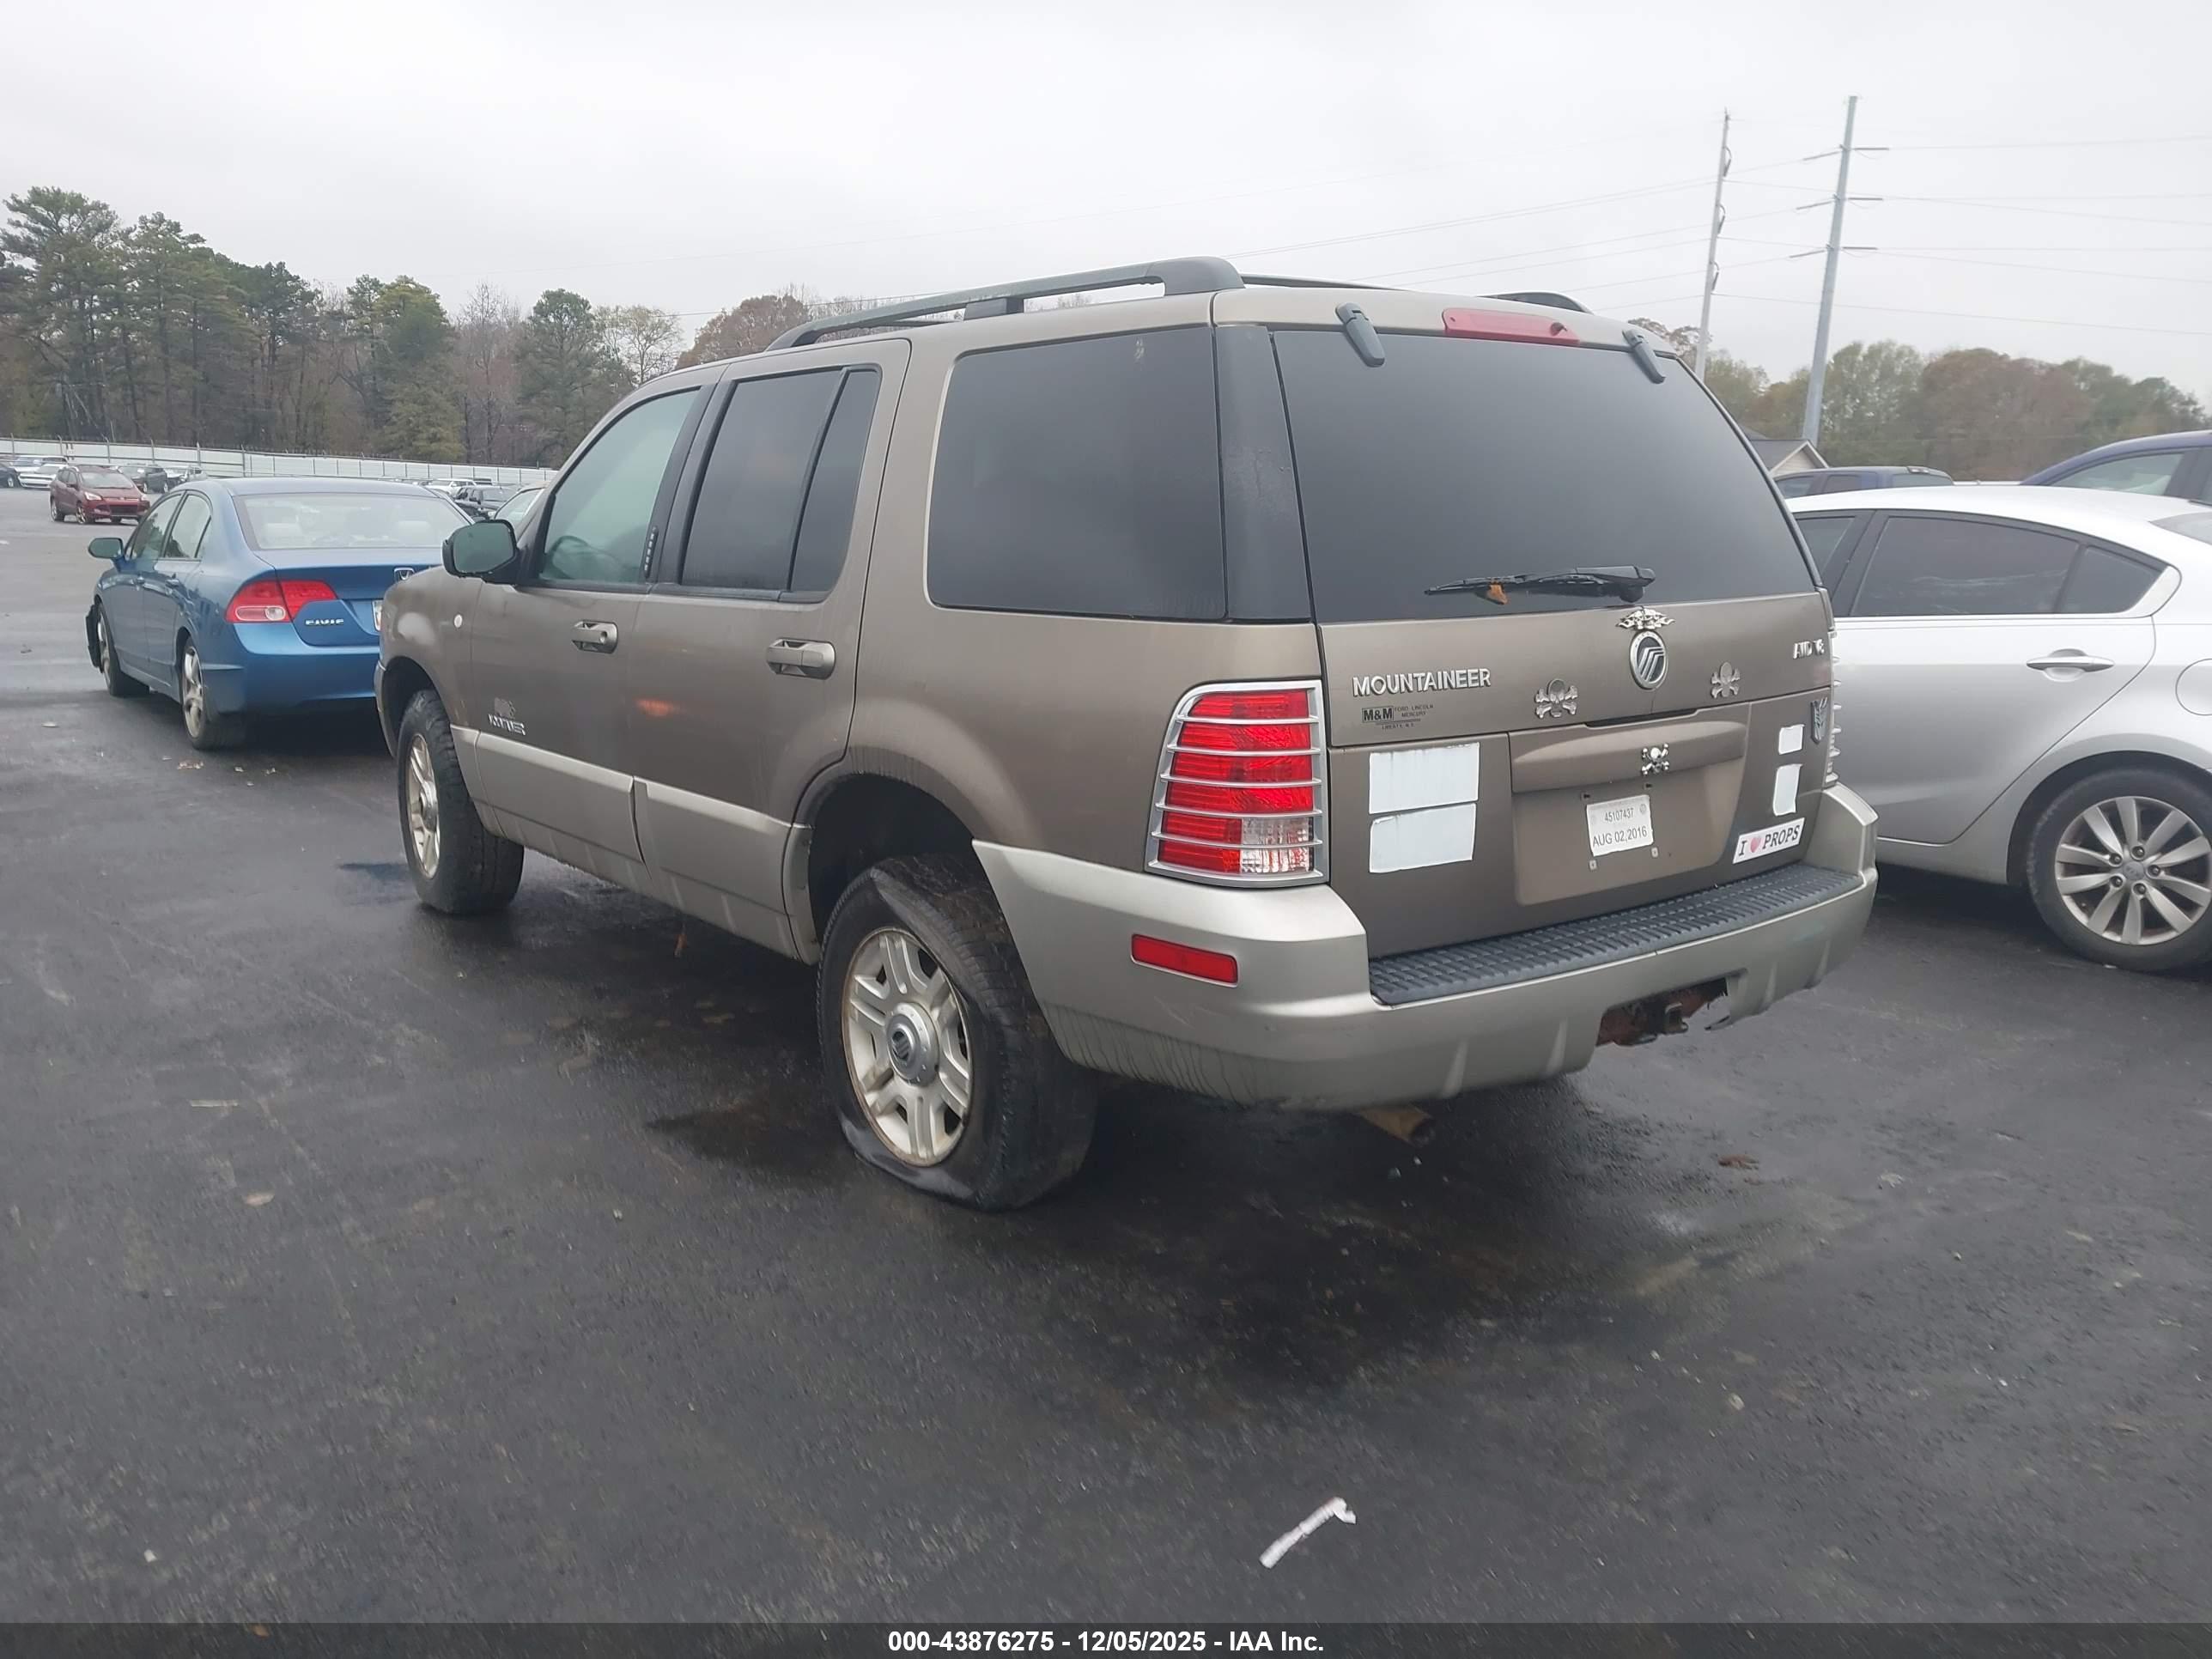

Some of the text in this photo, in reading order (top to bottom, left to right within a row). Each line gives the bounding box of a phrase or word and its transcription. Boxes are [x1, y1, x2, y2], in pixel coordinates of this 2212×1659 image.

[1352, 668, 1492, 697] MOUNTAINEER
[1363, 708, 1393, 721] M&M
[1604, 808, 1634, 823] 45107437
[1593, 825, 1648, 848] AUG 02,2016
[1739, 824, 1801, 857] I PROPS
